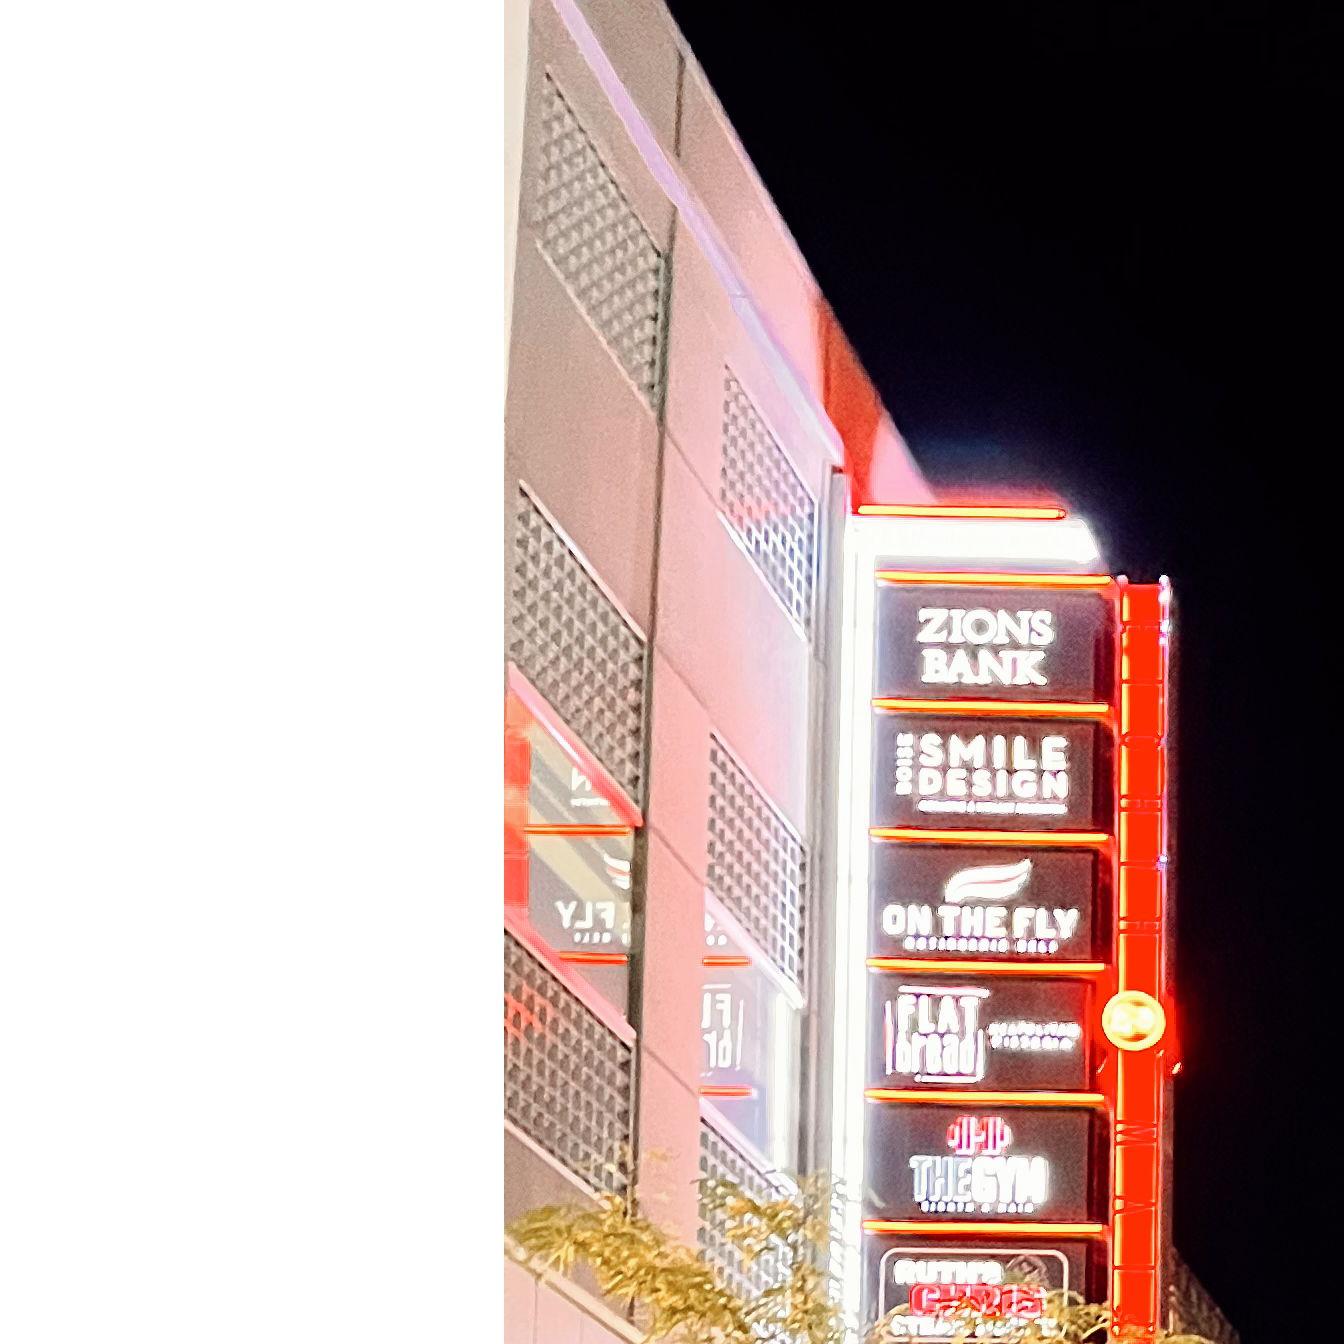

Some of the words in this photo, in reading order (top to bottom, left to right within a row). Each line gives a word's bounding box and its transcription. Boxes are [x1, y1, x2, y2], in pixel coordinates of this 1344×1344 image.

[917, 607, 1055, 645] ZIONS
[921, 647, 1049, 687] BANK
[918, 732, 1069, 771] SMILE
[917, 768, 1069, 799] DESIGN
[881, 903, 933, 936] ON
[937, 904, 1009, 938] THE
[1012, 906, 1080, 940] FLY
[898, 993, 980, 1035] FLAT
[895, 1030, 977, 1076] bread
